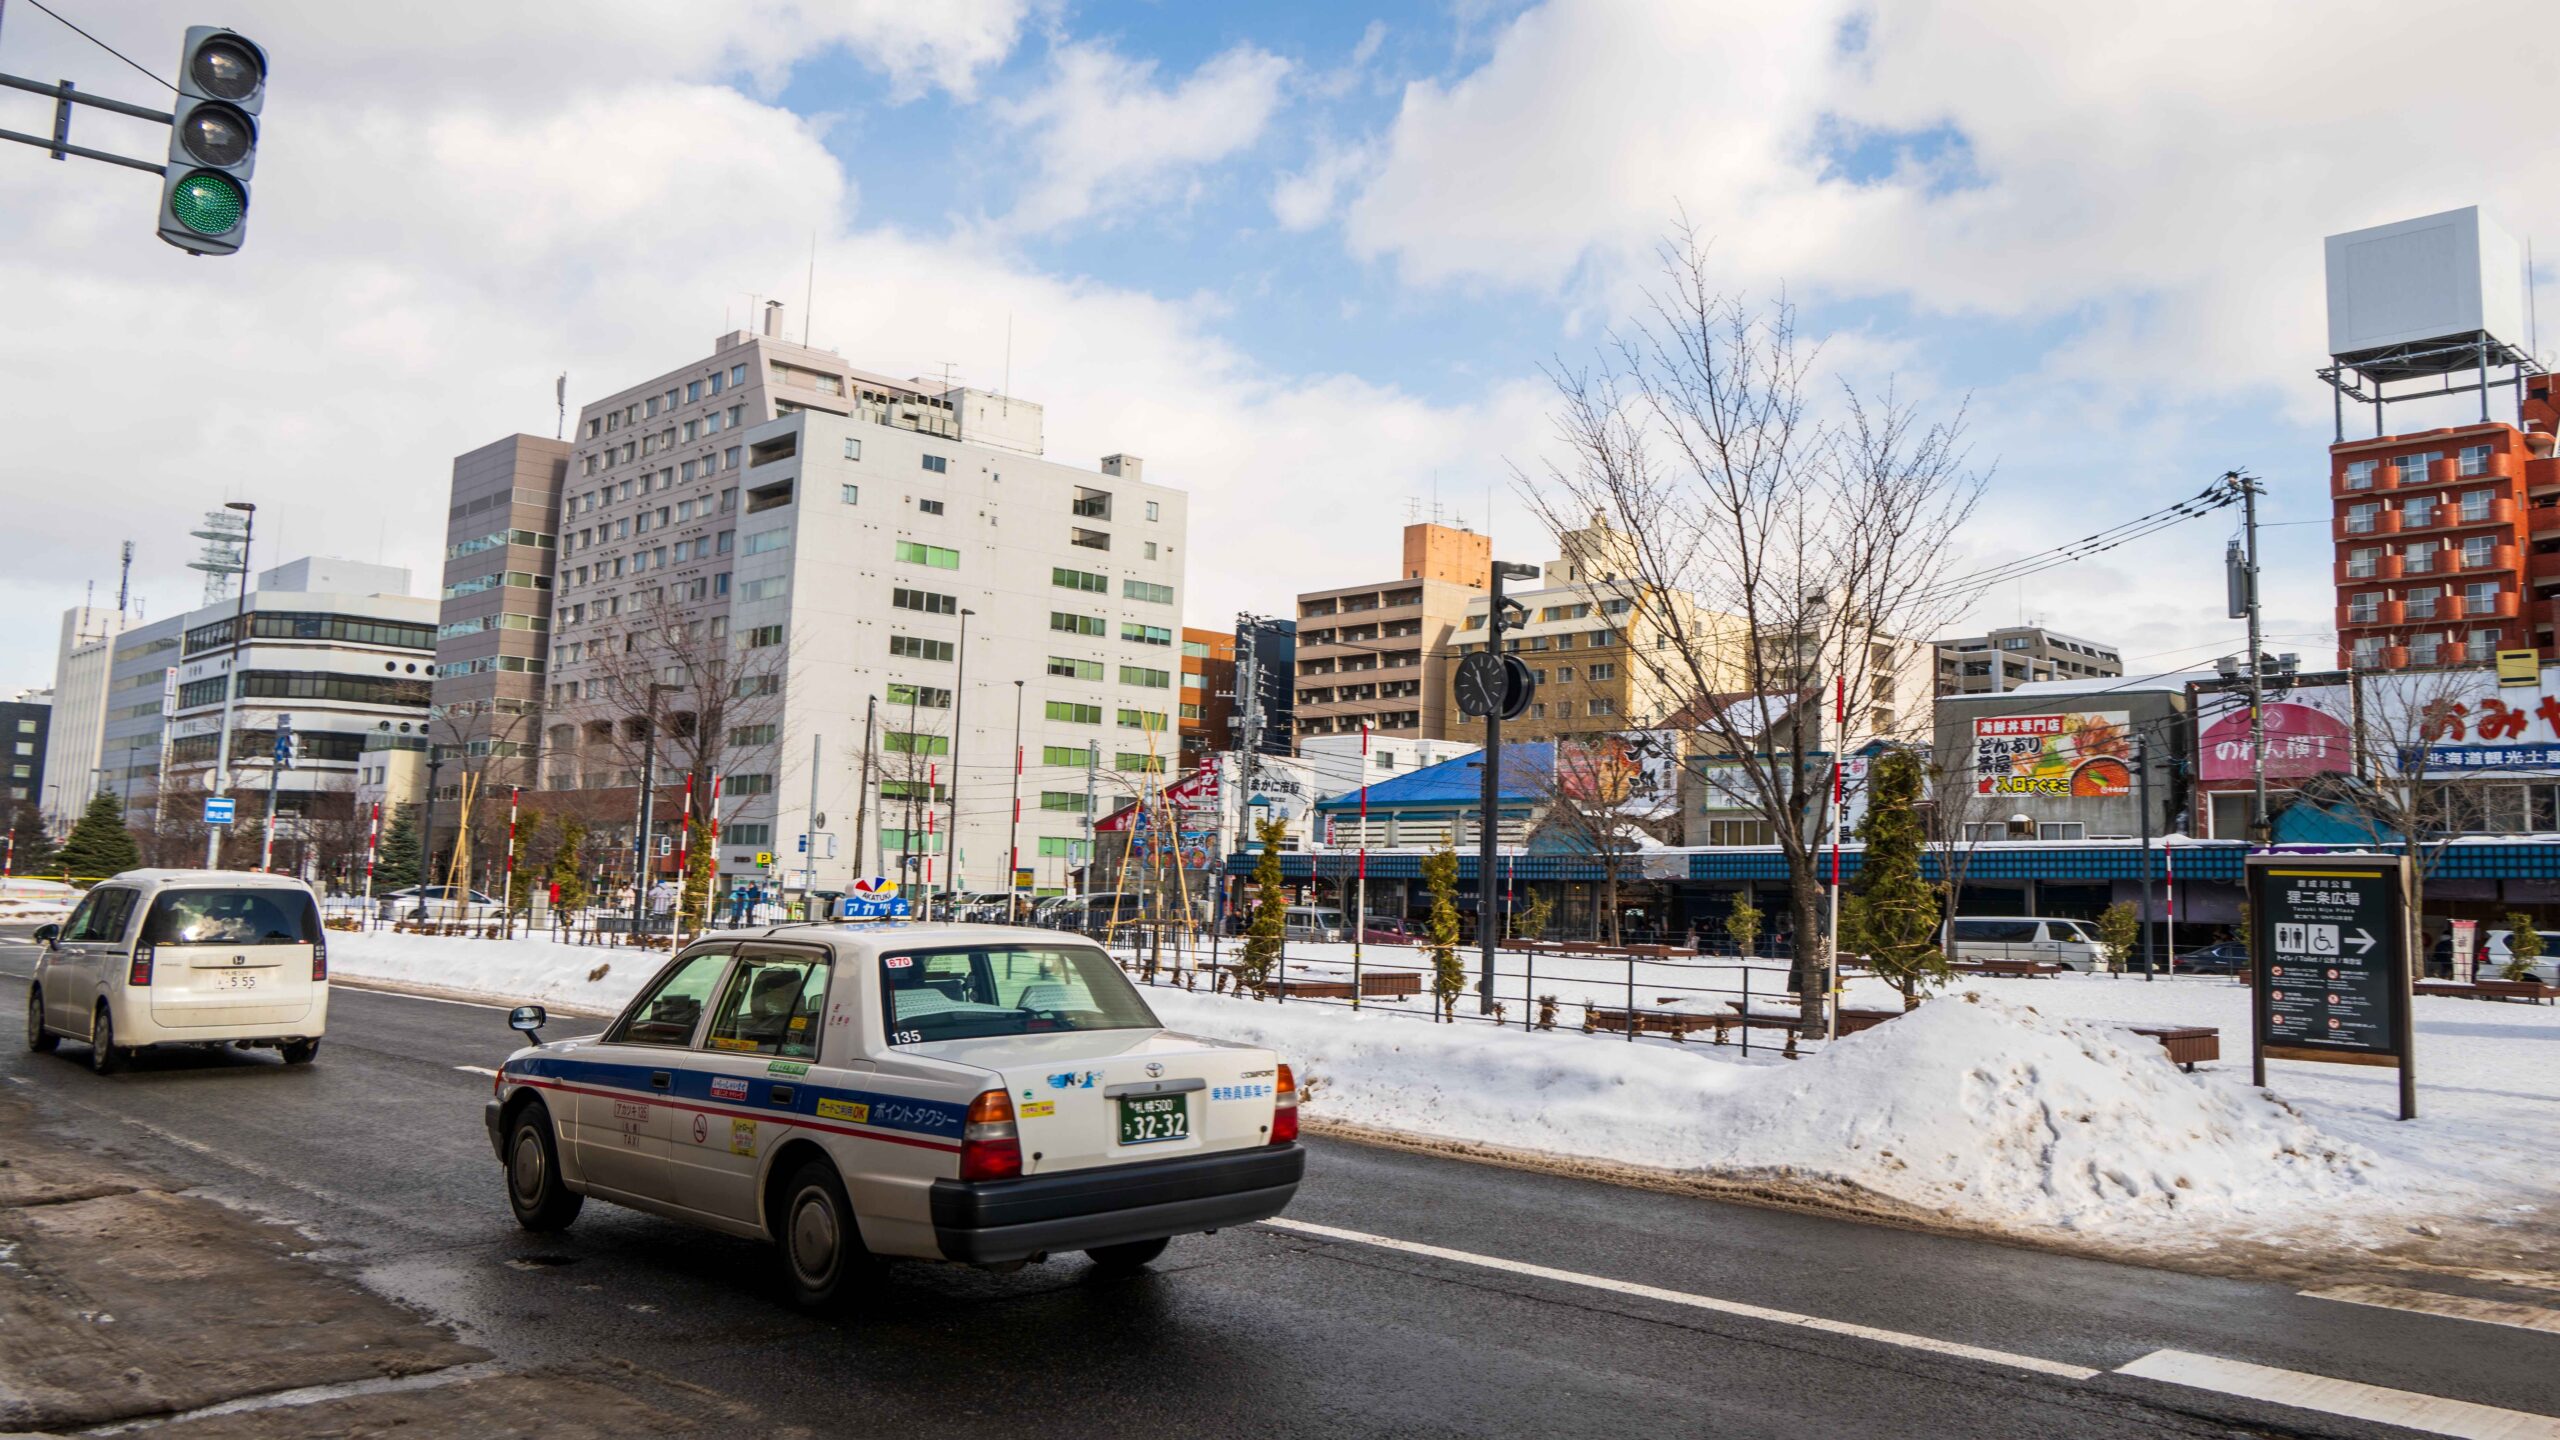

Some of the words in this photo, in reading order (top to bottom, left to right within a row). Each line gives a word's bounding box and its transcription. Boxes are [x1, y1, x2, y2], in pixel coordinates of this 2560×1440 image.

[1980, 719, 2060, 734] 海鮮丼専門店
[1979, 737, 2042, 754] どんぶり
[1978, 754, 2011, 773] 茶屋
[1247, 778, 1300, 795] 条かに市場
[1996, 776, 2070, 793] 入口すぐそこ
[761, 854, 768, 863] P
[861, 892, 892, 901] AKATUKI
[2287, 890, 2360, 906] 狸二条広場
[846, 902, 906, 915] アカツキ
[889, 957, 910, 967] 670
[892, 1030, 922, 1045] 135
[1211, 1085, 1272, 1101] 乗務員募集中
[1155, 1099, 1173, 1112] 500
[874, 1102, 958, 1127] ポイントタクシー
[1133, 1112, 1186, 1140] 32-32
[623, 1134, 640, 1148] TAXI
